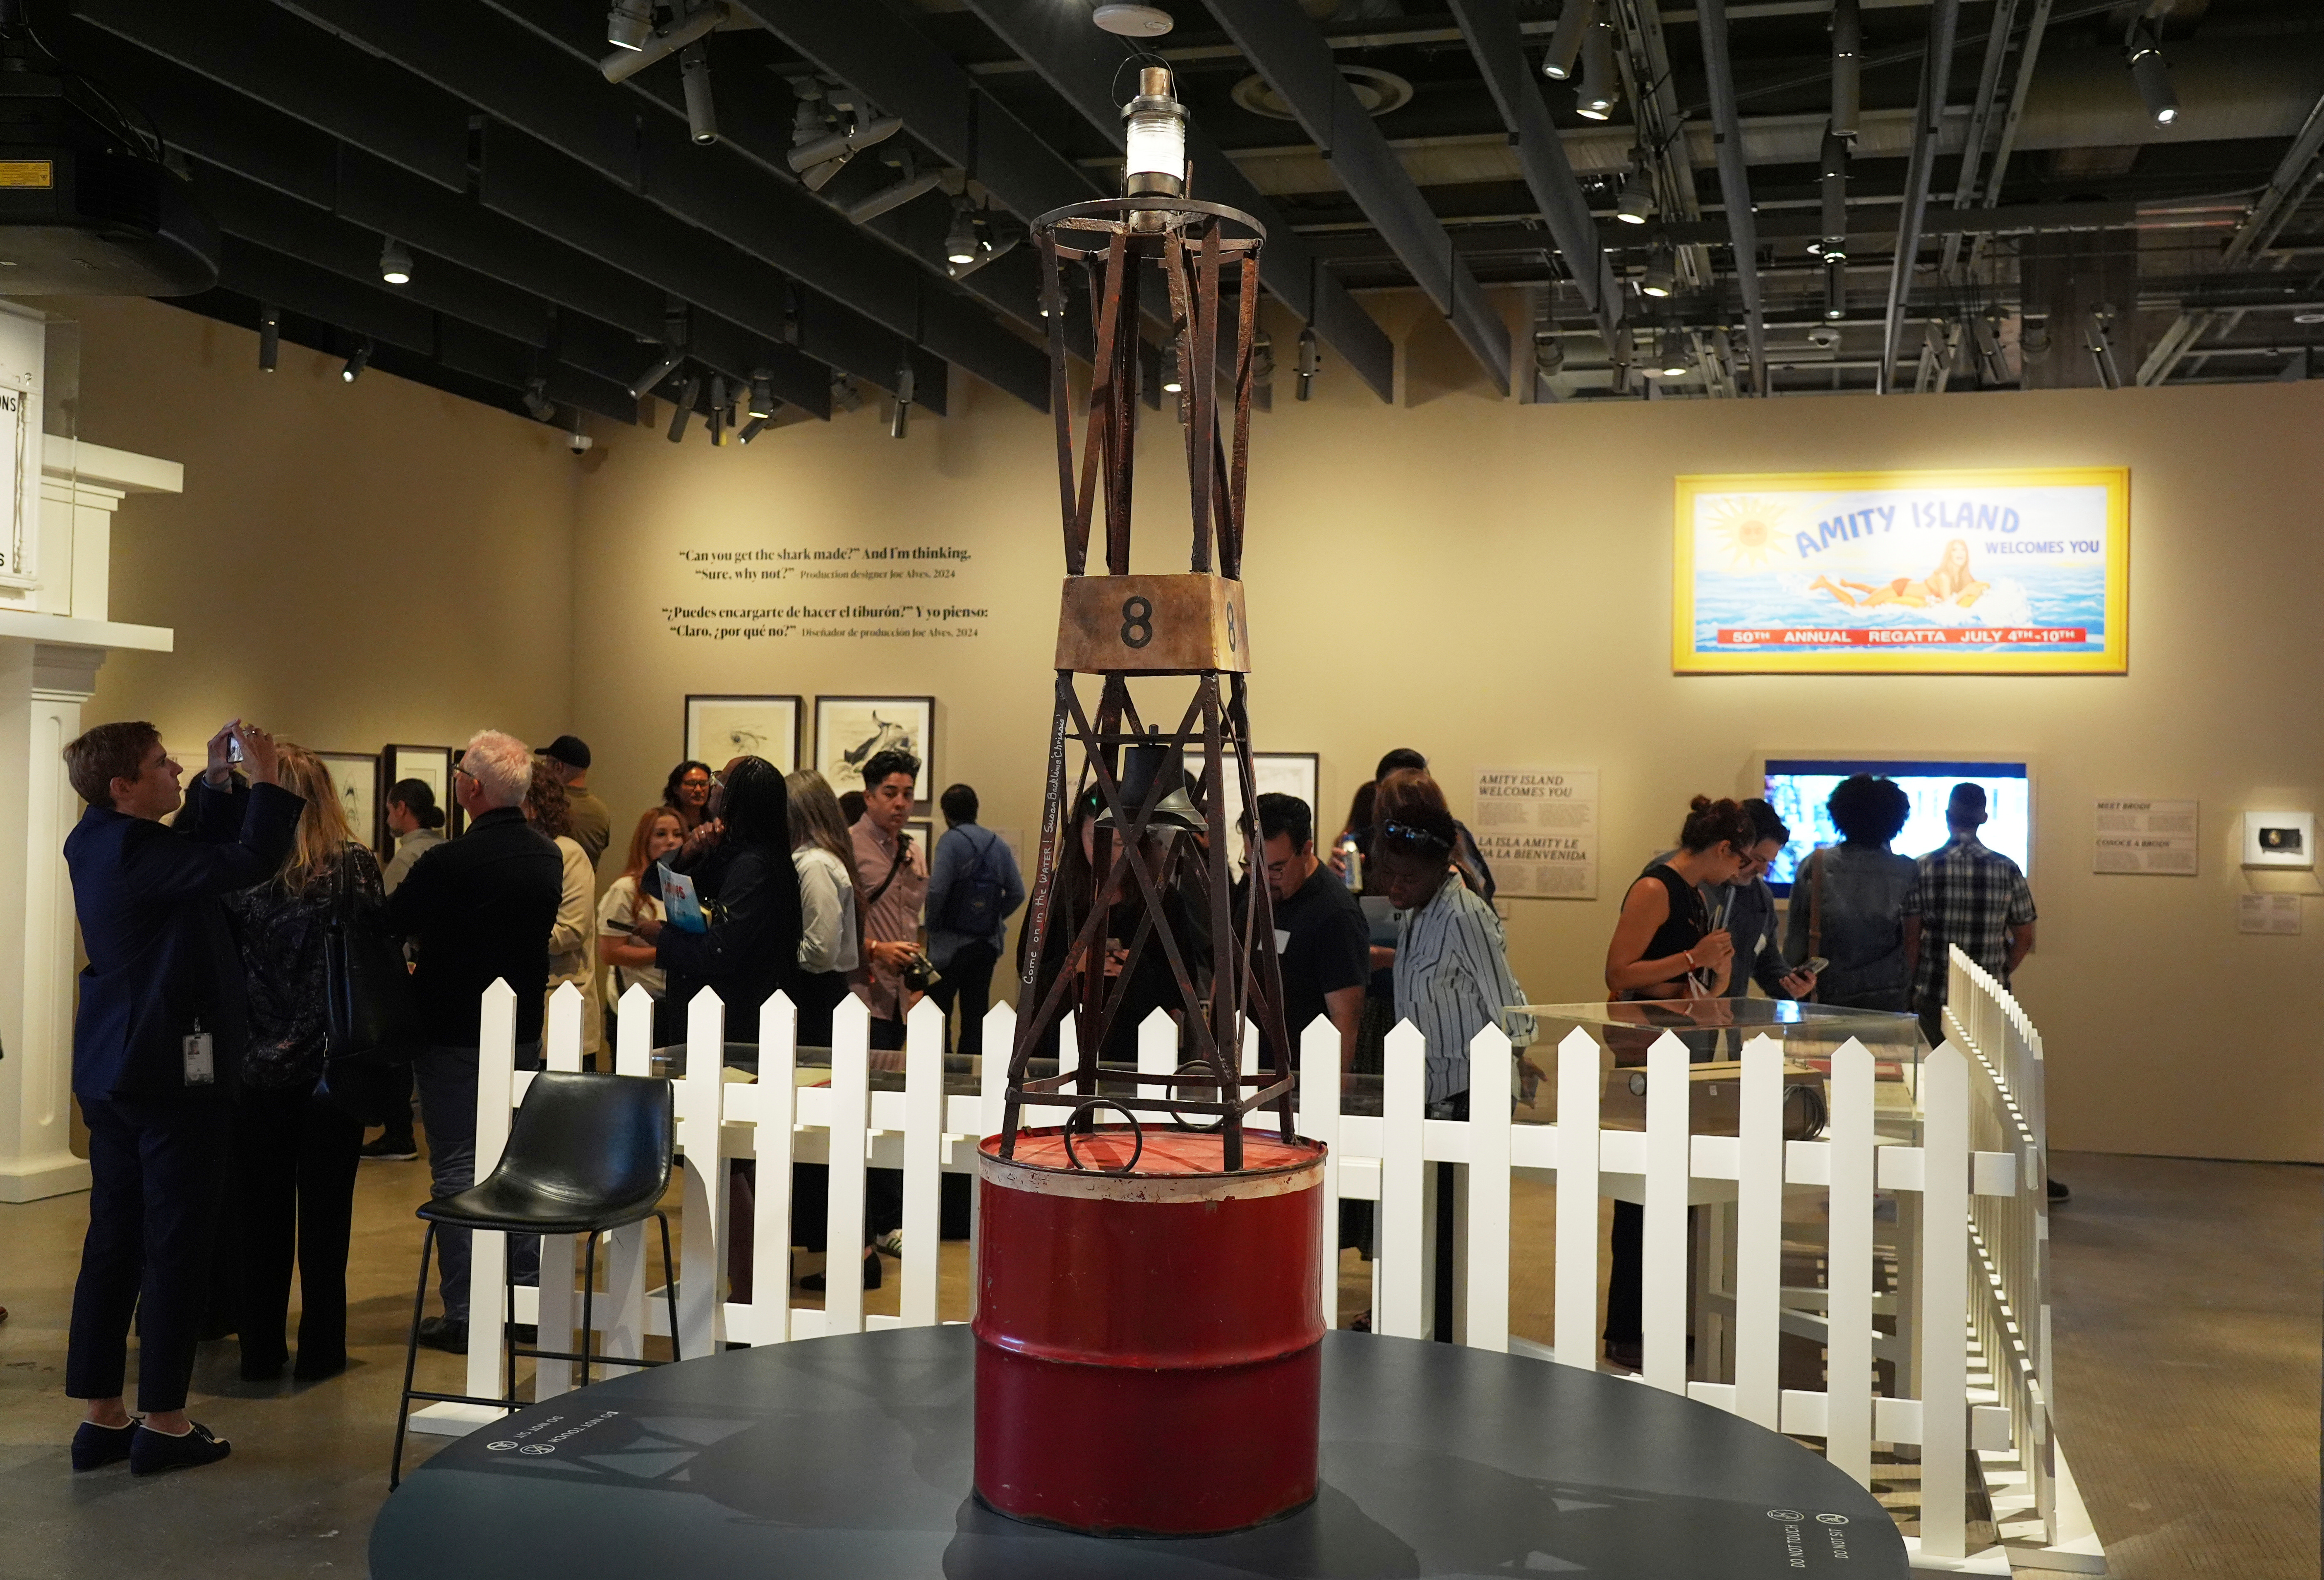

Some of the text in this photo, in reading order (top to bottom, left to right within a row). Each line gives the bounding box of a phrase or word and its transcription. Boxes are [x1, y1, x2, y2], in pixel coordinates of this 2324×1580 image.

[1796, 502, 2019, 558] AMITY ISLAND
[1986, 540, 2099, 553] WELCOMES YOU
[711, 551, 732, 564] you
[734, 551, 752, 563] get
[756, 549, 775, 560] the
[777, 548, 811, 560] shark
[862, 547, 887, 559] And
[735, 568, 758, 583] why
[801, 569, 848, 578] Production
[851, 569, 887, 580] designer
[933, 569, 955, 578] 2024
[719, 608, 783, 621] encargarte
[787, 606, 800, 618] de
[803, 606, 837, 618] hacer
[839, 606, 850, 618] el
[916, 606, 923, 618] Y
[927, 609, 940, 621] yo
[1120, 596, 1152, 648] 8
[1227, 601, 1235, 652] 8
[714, 627, 741, 640] ¿por
[744, 624, 765, 640] qué
[848, 628, 859, 637] de
[861, 628, 910, 639] producción
[956, 628, 978, 637] 2024
[1733, 631, 1770, 643] 50TH
[1784, 631, 1852, 643] ANNUAL
[1868, 631, 1946, 643] REGATTA
[1960, 630, 2002, 642] JULY
[1480, 774, 1564, 785] AMITY ISLAND
[1480, 786, 1572, 797] WELCOMES YOU
[1044, 801, 1056, 833] Susan
[1478, 837, 1579, 849] LA ISLA AMITY LE
[1496, 849, 1511, 859] LA
[1514, 849, 1586, 860] BIENVENIDA
[1035, 888, 1047, 906] the
[1036, 912, 1043, 922] in
[1034, 928, 1041, 943] on
[1024, 950, 1037, 985] Come
[528, 1422, 551, 1431] NOT
[580, 1418, 604, 1428] NOT
[547, 1428, 585, 1443] TOUCH
[1784, 1524, 1806, 1568] DO NOT TOUCH
[1828, 1528, 1849, 1559] DO NOT SIT
